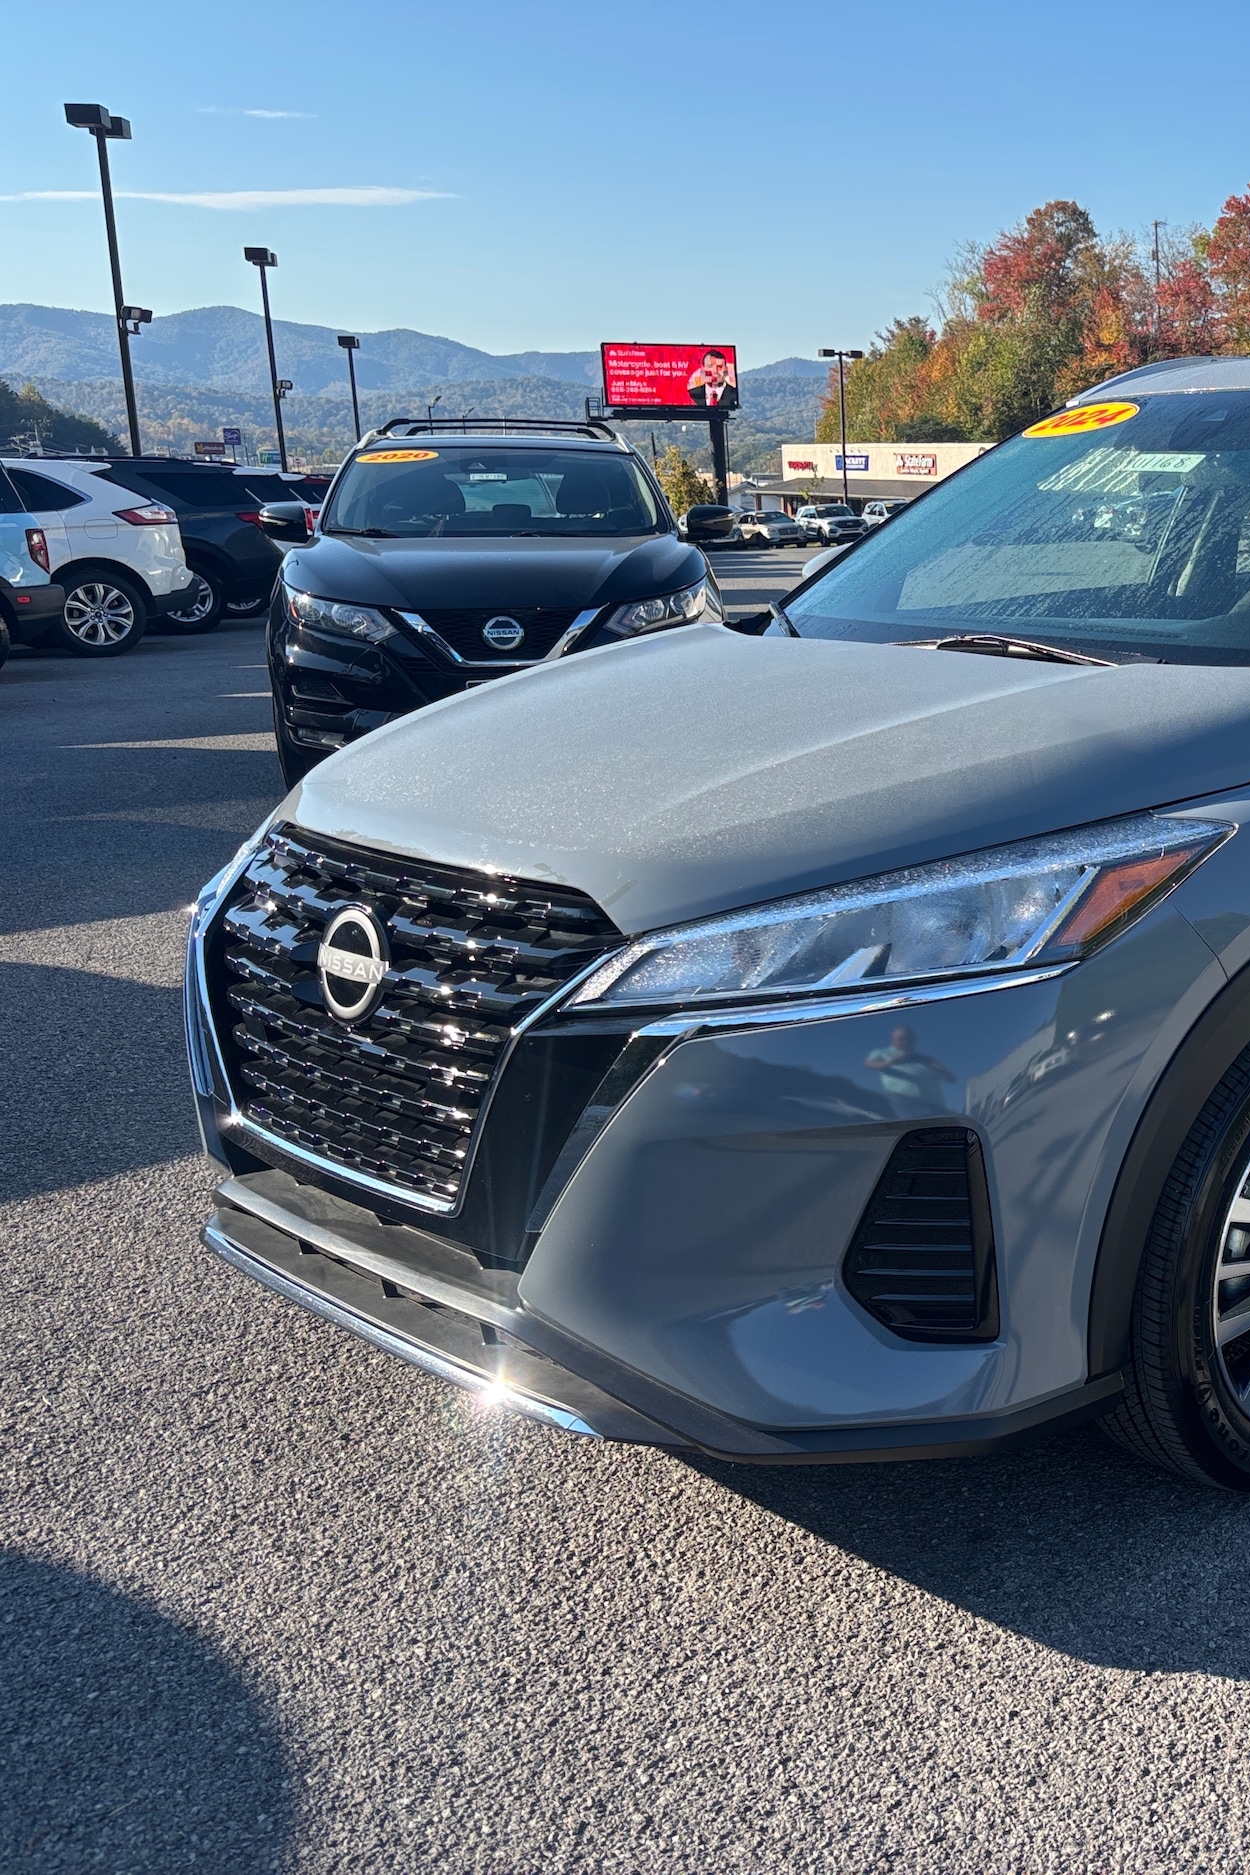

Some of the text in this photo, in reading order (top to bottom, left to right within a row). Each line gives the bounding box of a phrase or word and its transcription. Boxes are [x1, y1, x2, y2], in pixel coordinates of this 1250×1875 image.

[1030, 407, 1134, 433] 2024
[364, 452, 430, 461] 2020
[319, 947, 384, 981] NISSAN
